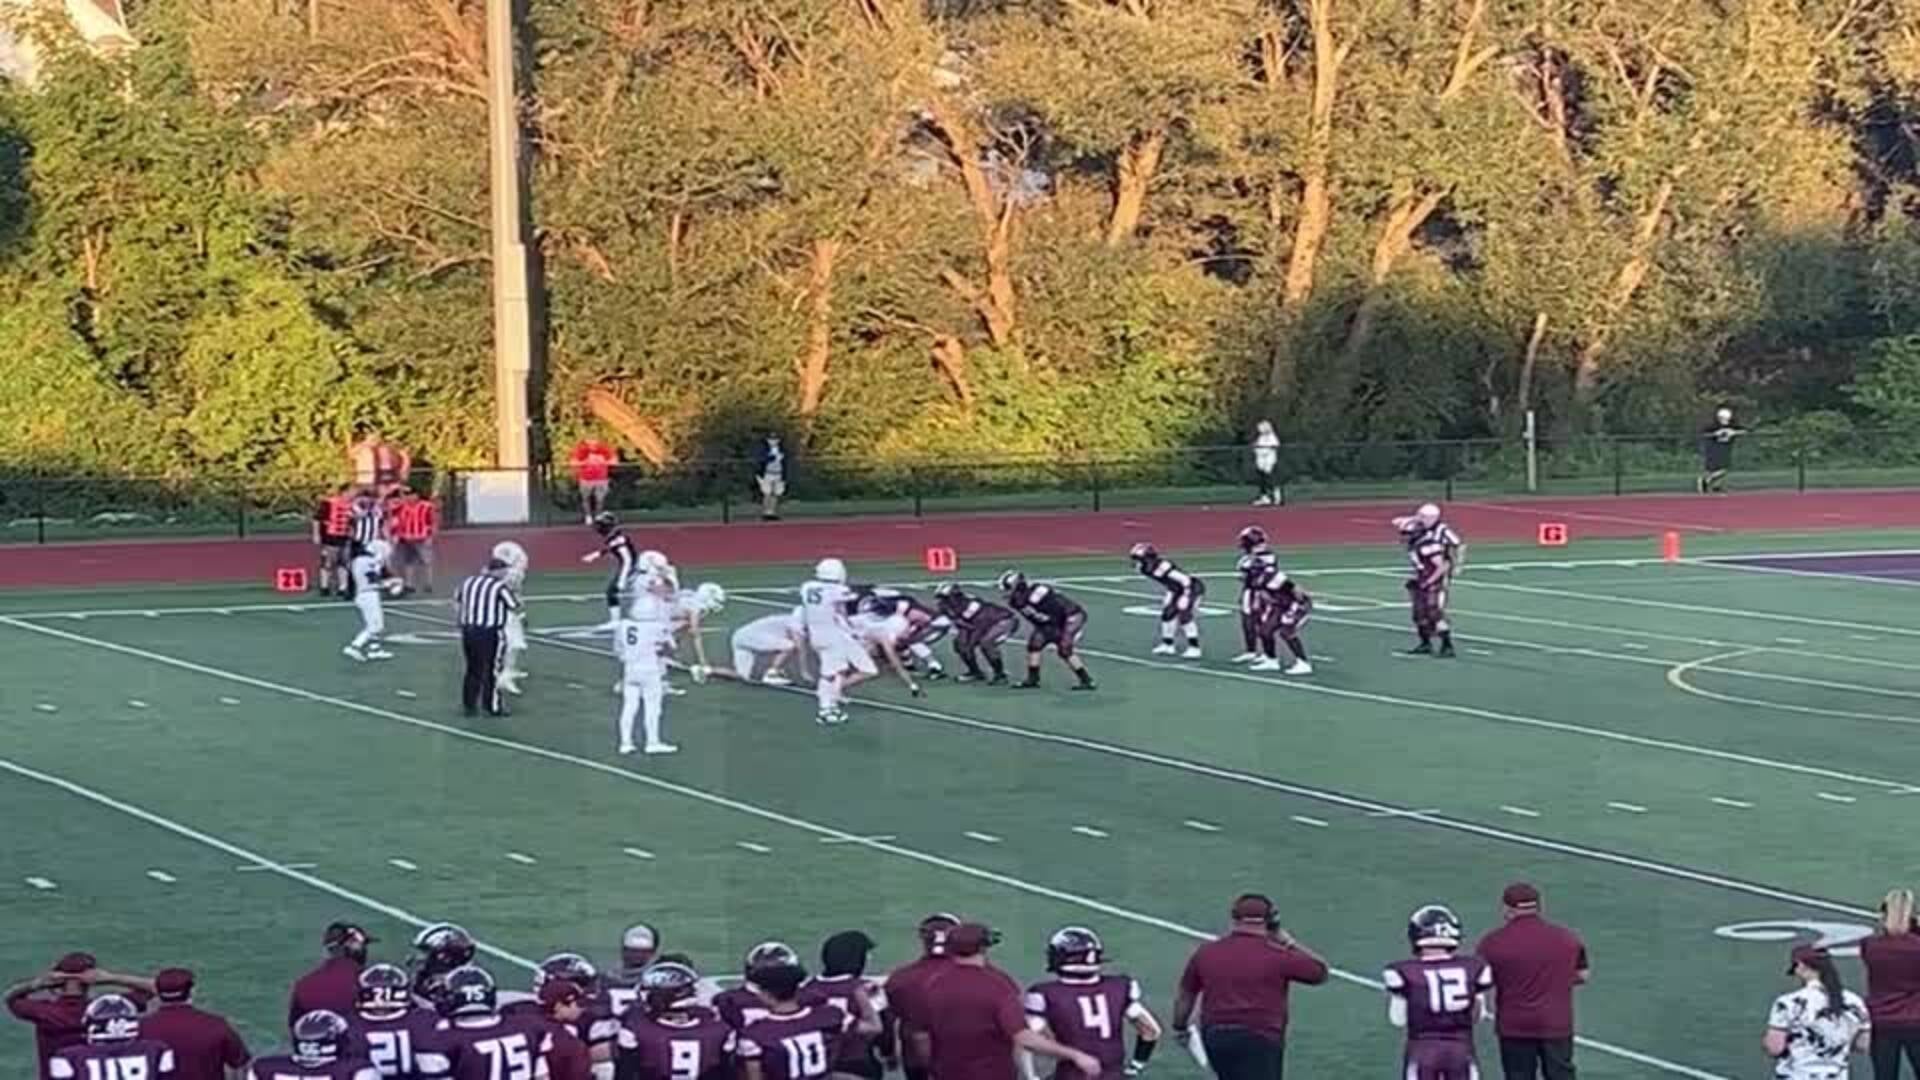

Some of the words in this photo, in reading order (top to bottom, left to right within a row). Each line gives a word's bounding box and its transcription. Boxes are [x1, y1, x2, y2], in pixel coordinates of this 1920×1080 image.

[1544, 527, 1562, 542] G
[626, 625, 638, 646] 6
[1424, 968, 1470, 1012] 12
[1077, 994, 1110, 1039] 4
[366, 1030, 411, 1075] 21
[473, 1034, 532, 1080] 75
[670, 1040, 700, 1080] 9
[781, 1032, 827, 1079] 10
